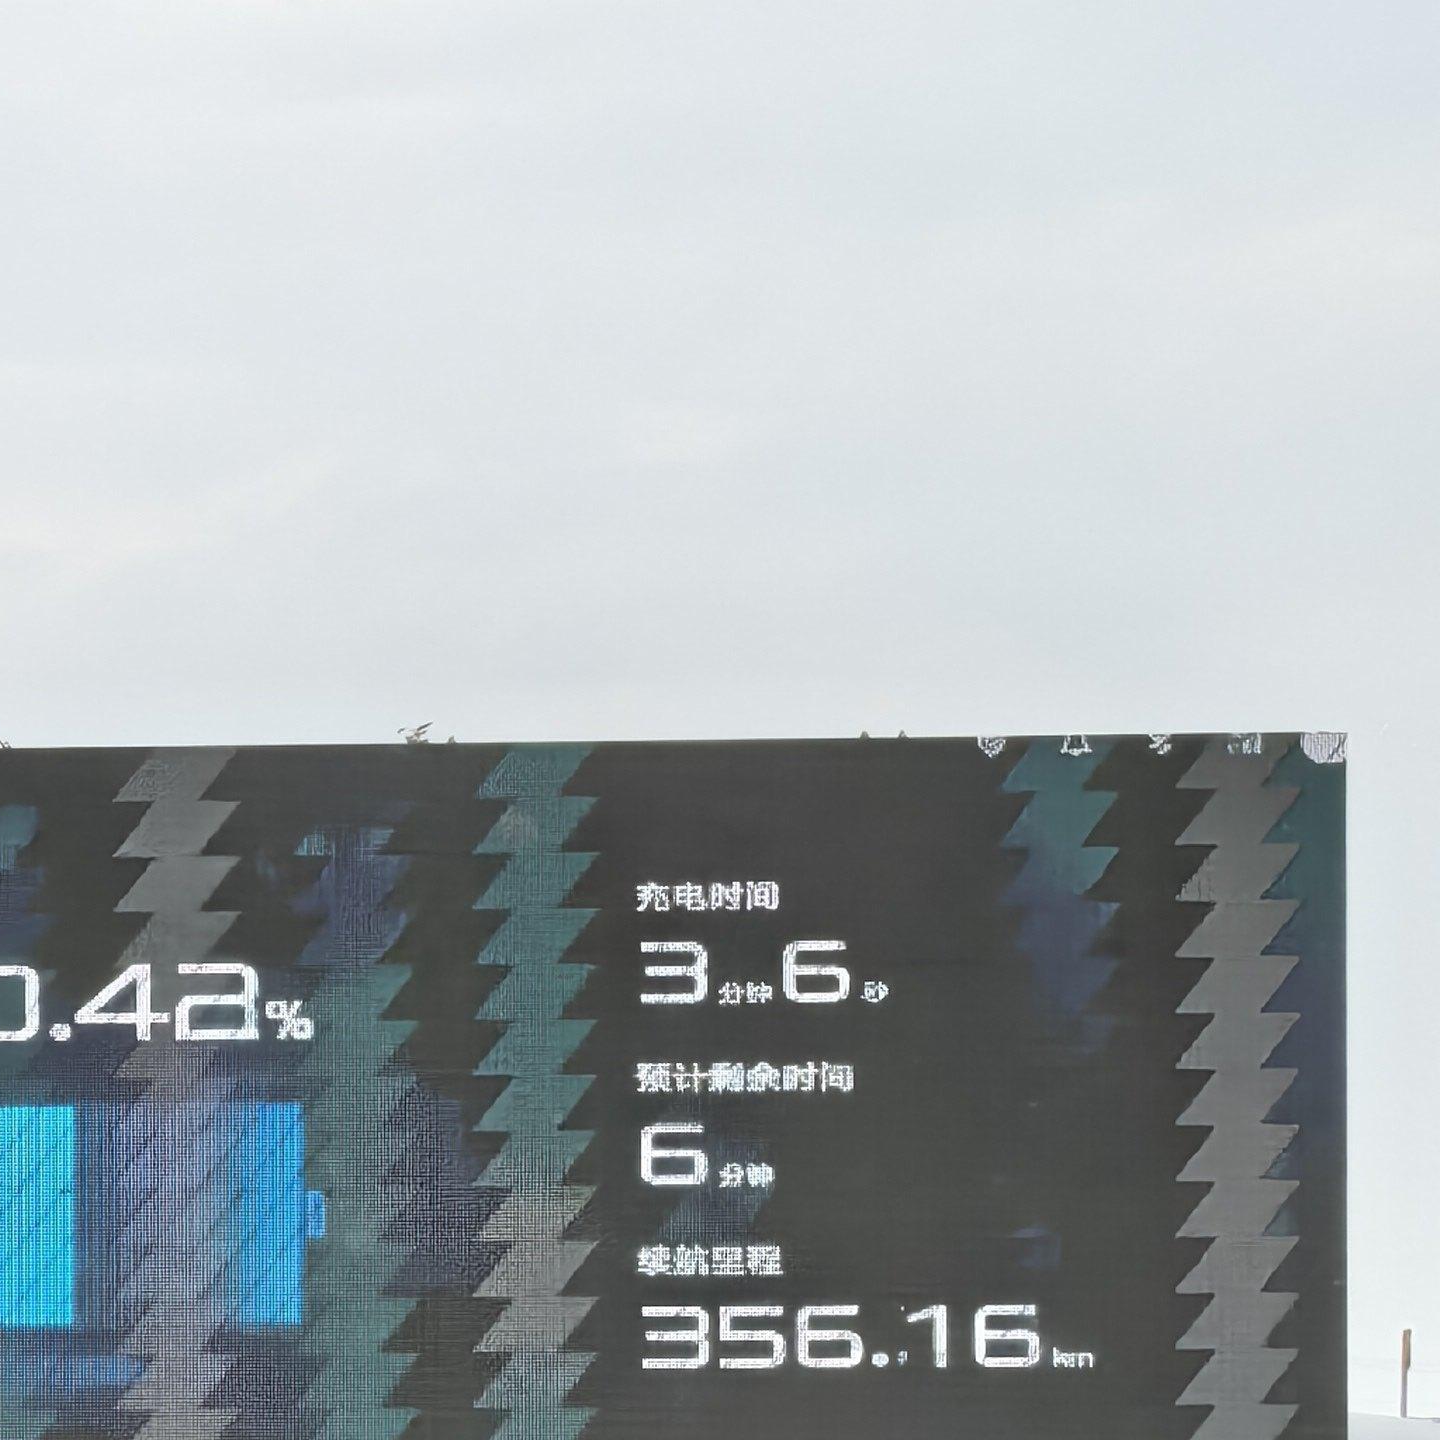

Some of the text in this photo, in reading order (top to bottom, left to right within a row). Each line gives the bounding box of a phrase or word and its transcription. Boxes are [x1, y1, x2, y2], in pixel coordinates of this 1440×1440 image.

[635, 880, 780, 912] 充电时间
[634, 1061, 856, 1094] 预计剩余时间
[636, 1243, 784, 1277] 续航里程
